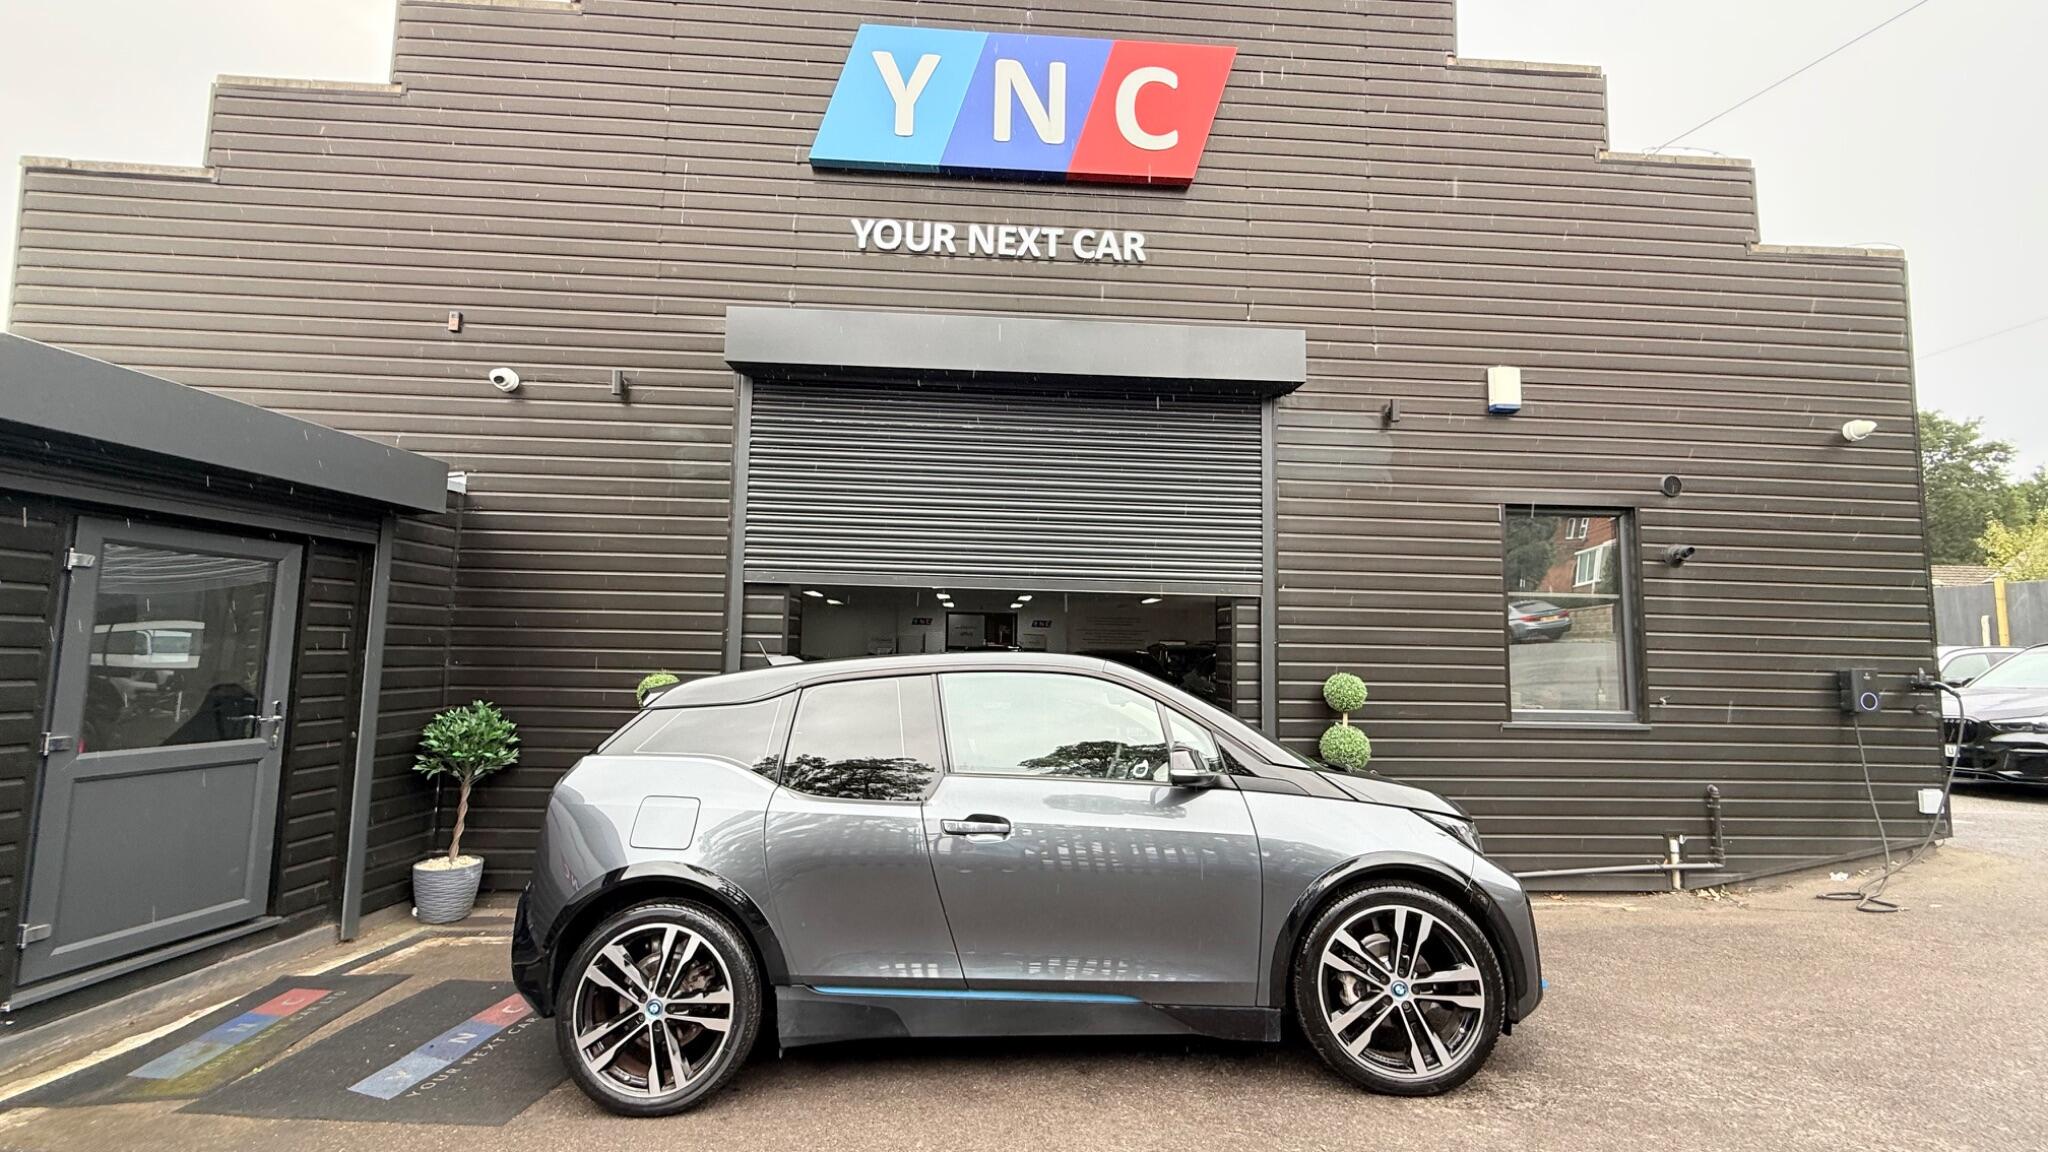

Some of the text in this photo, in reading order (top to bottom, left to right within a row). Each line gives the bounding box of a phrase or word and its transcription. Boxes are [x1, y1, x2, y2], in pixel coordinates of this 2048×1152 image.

[872, 51, 1179, 151] YNC
[851, 218, 1147, 262] YOUR NEXT CAR
[406, 1016, 540, 1098] YOUR NEXT CAR
